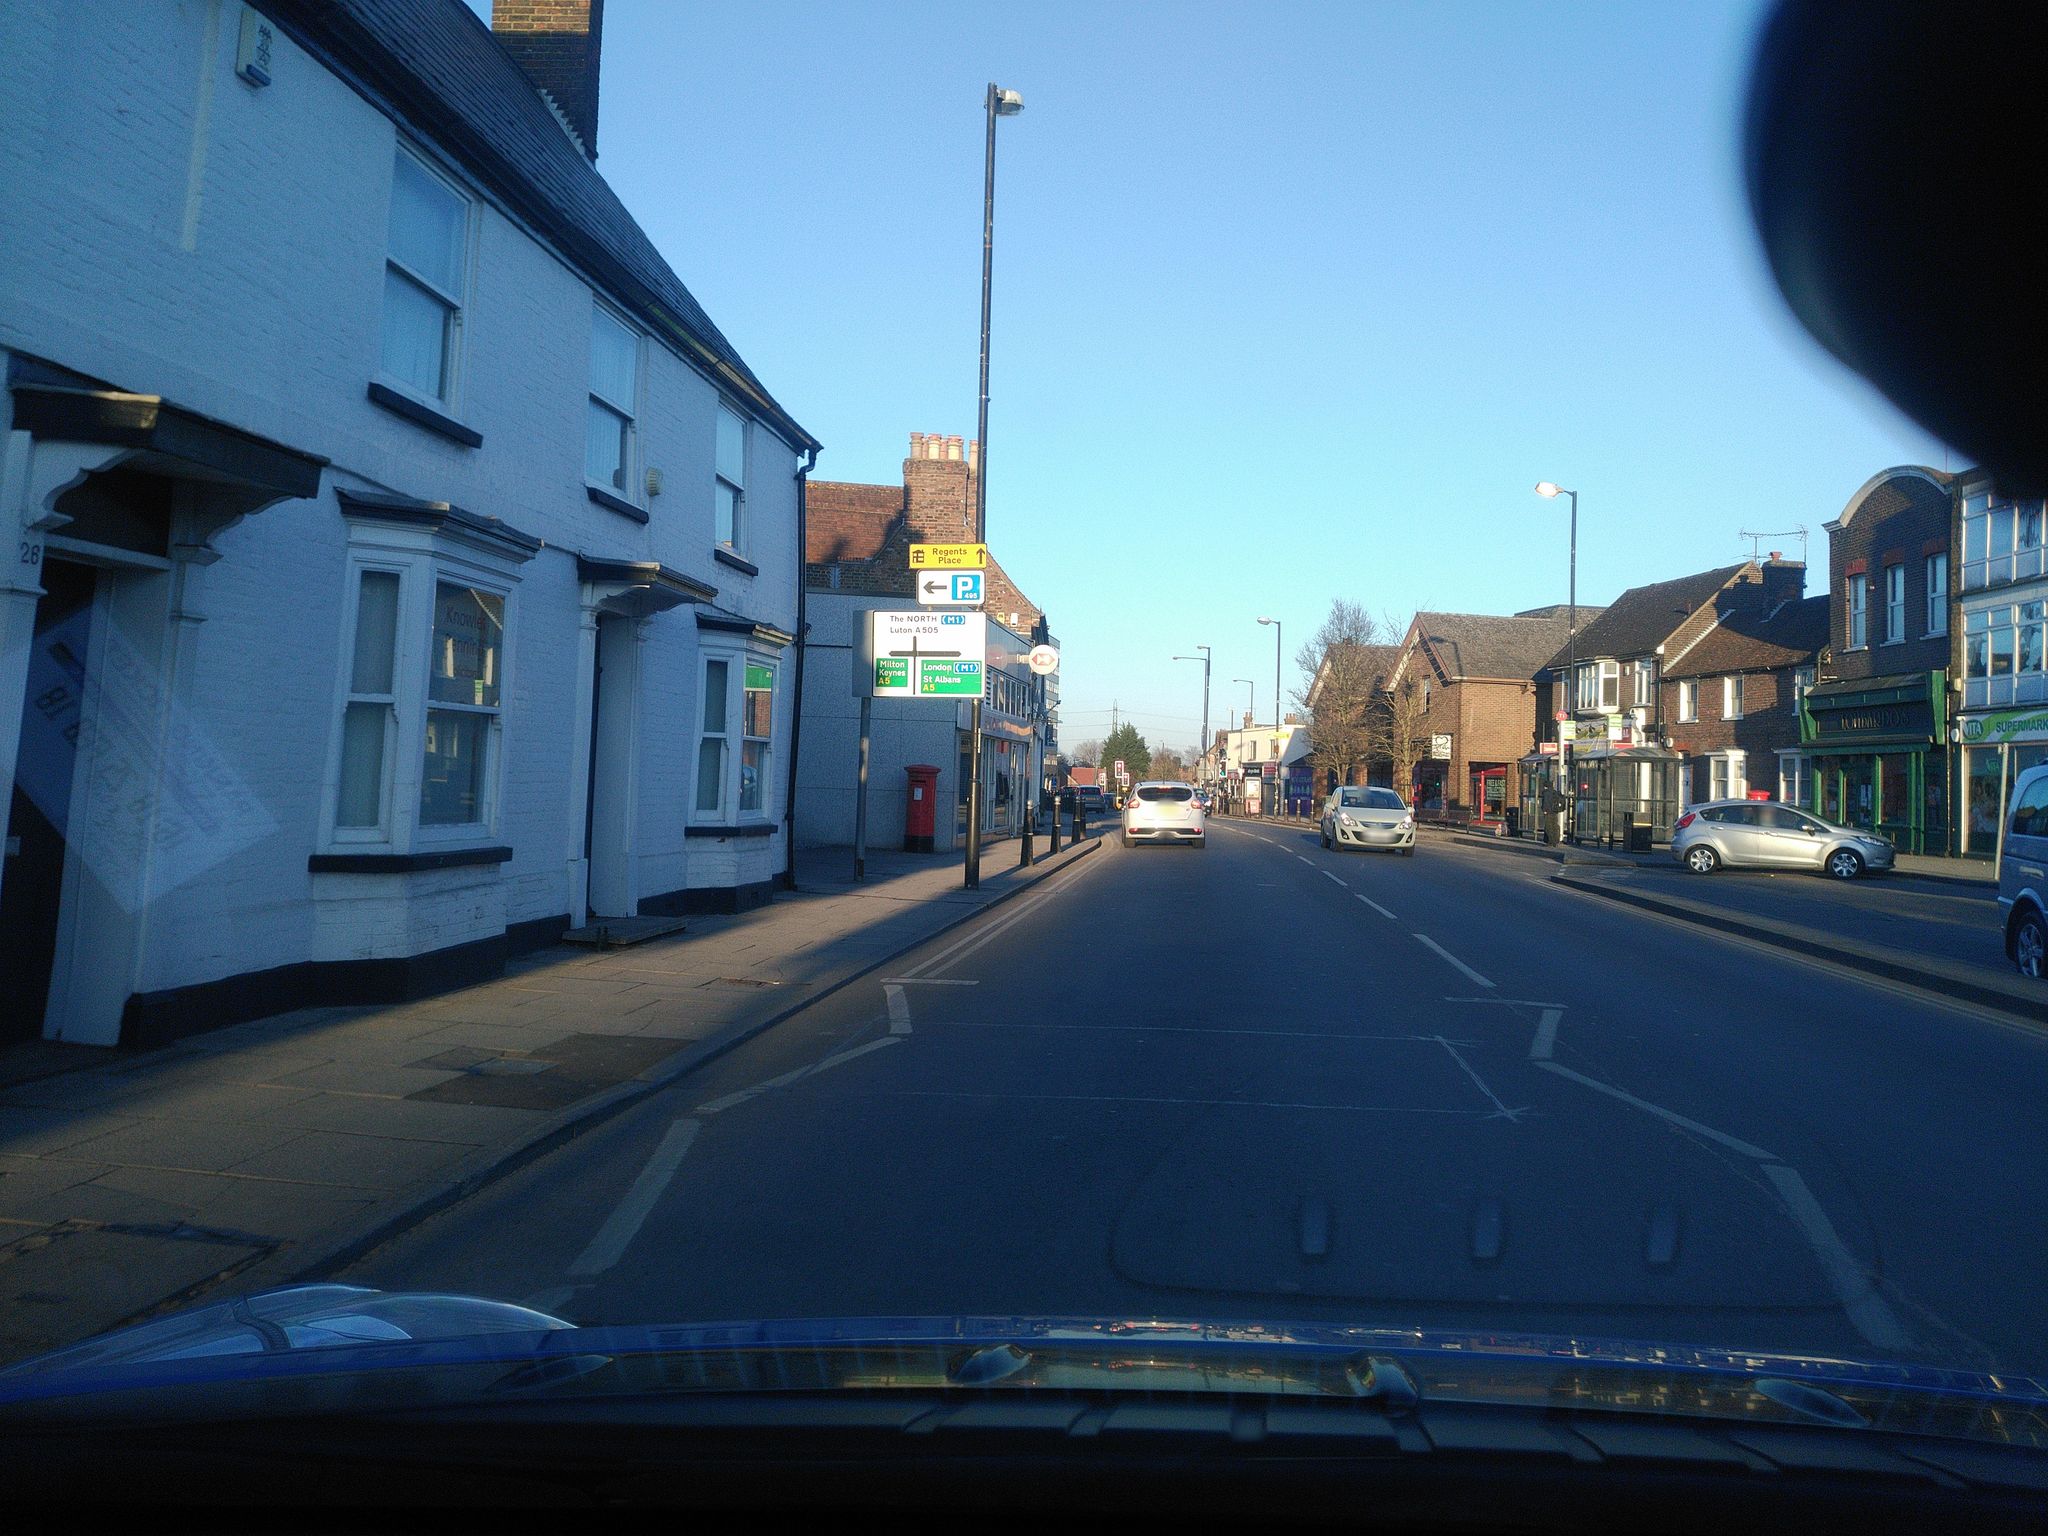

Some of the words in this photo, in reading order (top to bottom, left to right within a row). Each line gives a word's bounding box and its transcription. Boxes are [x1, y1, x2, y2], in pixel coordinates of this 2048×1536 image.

[932, 548, 968, 556] Regents
[956, 577, 973, 599] P
[941, 615, 965, 625] (M1)
[923, 663, 952, 671] London
[923, 675, 933, 683] St
[1964, 721, 1982, 736] VITA
